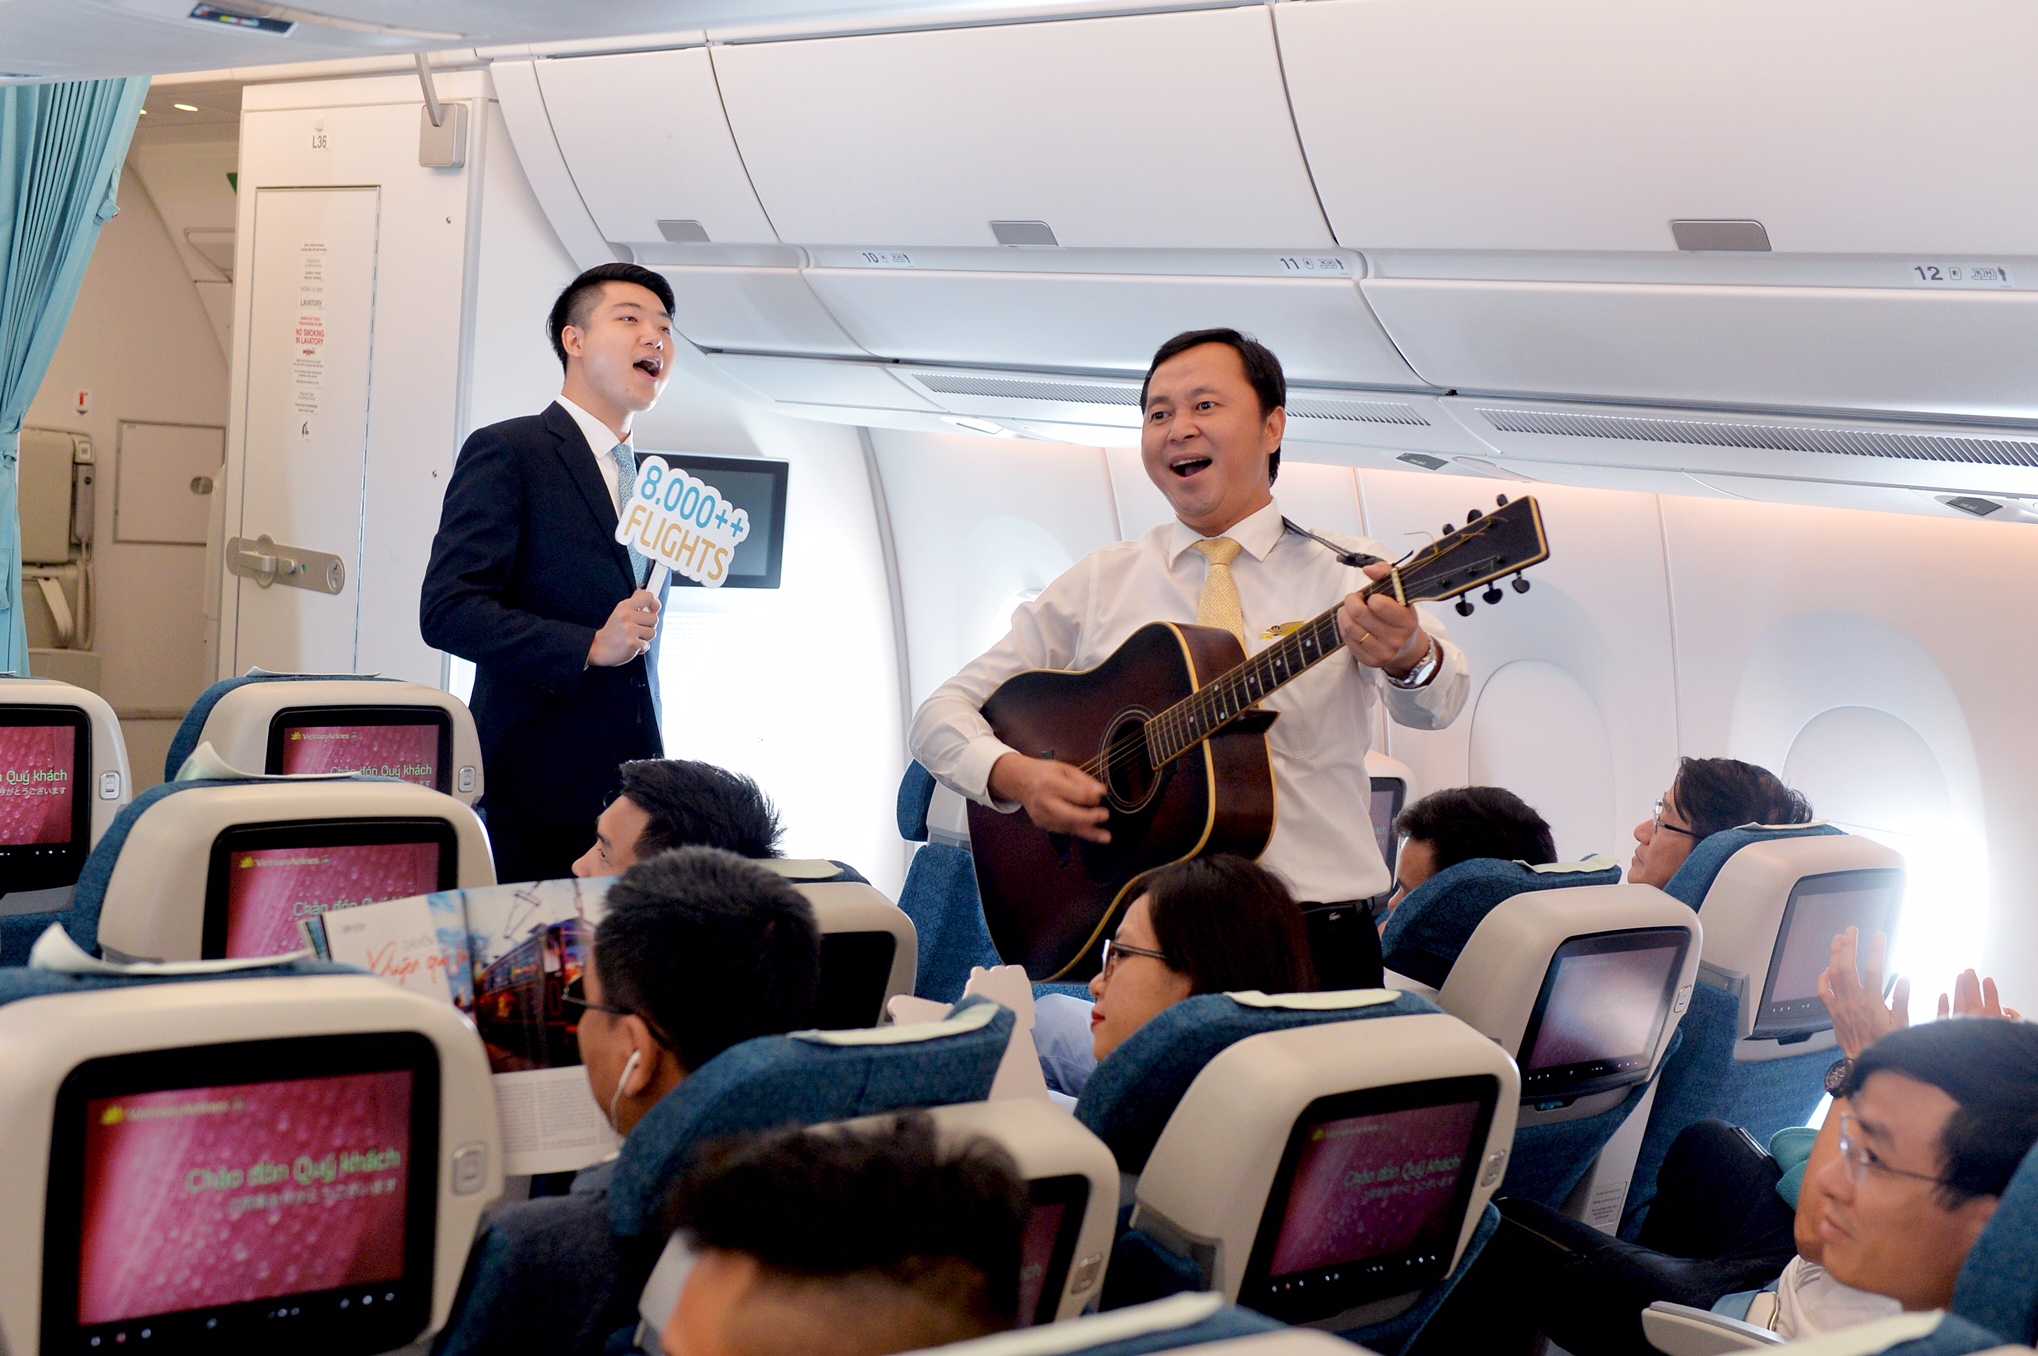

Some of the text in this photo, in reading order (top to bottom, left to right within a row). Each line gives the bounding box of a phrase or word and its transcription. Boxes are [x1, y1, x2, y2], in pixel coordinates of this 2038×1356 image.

[312, 135, 327, 149] L36
[862, 252, 879, 263] 10
[1280, 258, 1300, 270] 11
[1914, 266, 1944, 281] 12
[641, 465, 744, 537] 8.000++
[624, 504, 729, 581] FLIGHTS
[6, 769, 30, 785] Quý
[33, 769, 68, 782] khách
[381, 765, 401, 778] Quý
[403, 764, 432, 776] khách
[293, 1152, 337, 1186] Quý
[340, 1146, 400, 1174] khách
